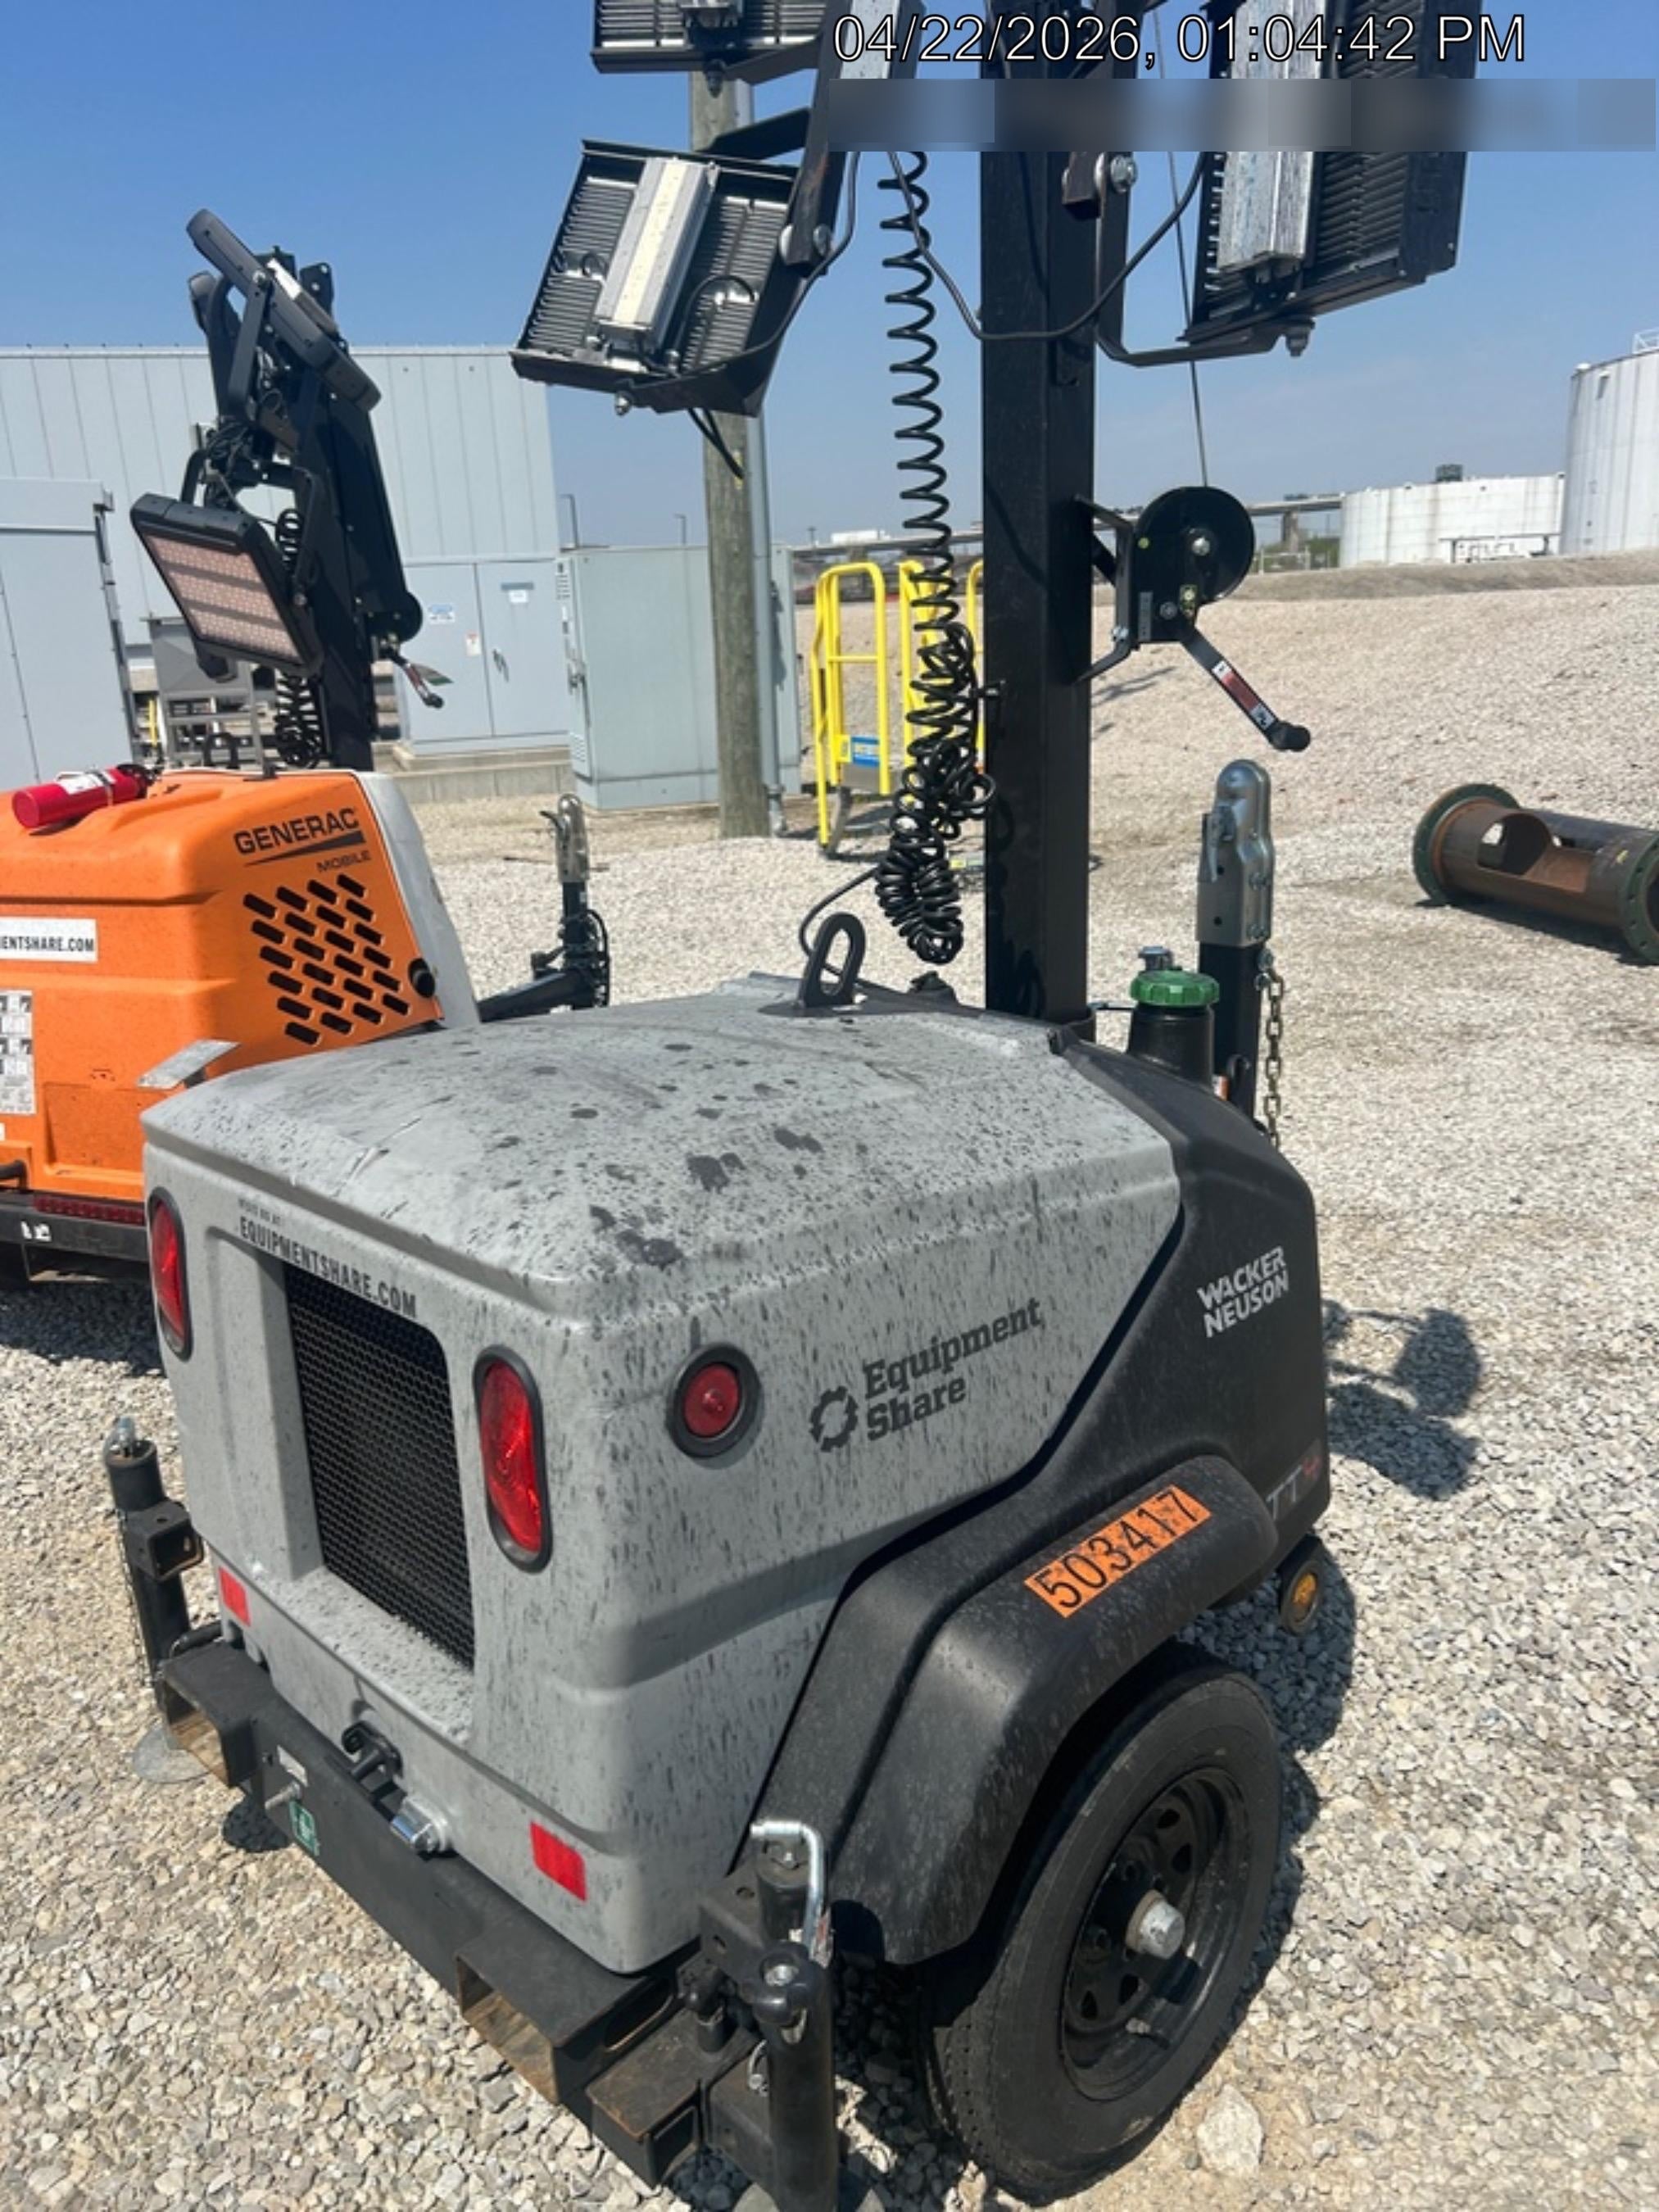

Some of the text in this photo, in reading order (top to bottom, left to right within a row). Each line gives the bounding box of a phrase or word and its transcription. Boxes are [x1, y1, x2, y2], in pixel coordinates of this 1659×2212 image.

[233, 807, 359, 854] GENERAC
[316, 850, 371, 873] MOBILE
[0, 936, 93, 952] ENTSHARE.COM
[239, 1216, 416, 1318] EQUIPMENTSHARE.COM
[1197, 1245, 1286, 1310] WACKER
[1203, 1270, 1289, 1338] NEUSON
[863, 1297, 1045, 1400] Equipment
[866, 1377, 966, 1442] Share
[1035, 1489, 1200, 1609] 503417
